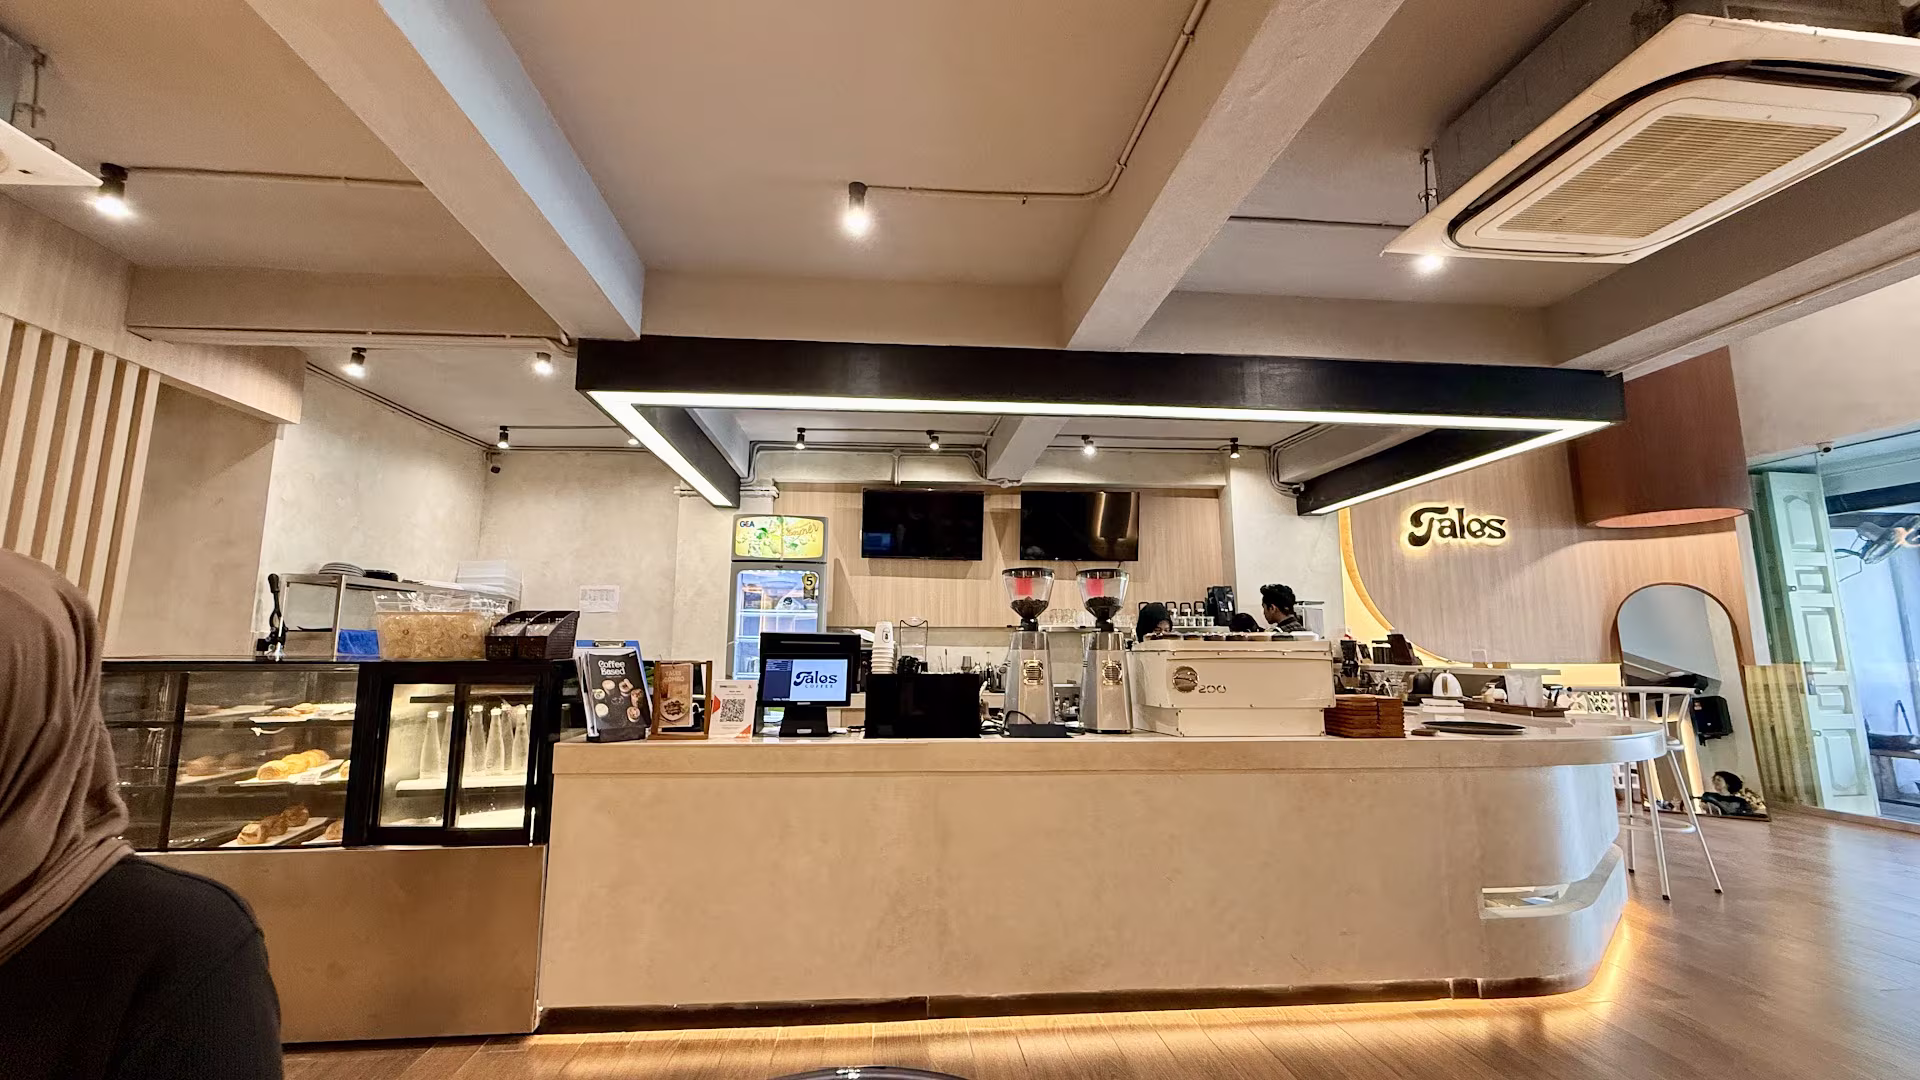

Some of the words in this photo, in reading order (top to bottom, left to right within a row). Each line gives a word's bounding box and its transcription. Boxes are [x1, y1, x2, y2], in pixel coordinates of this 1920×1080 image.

[739, 520, 755, 528] GEA
[1408, 506, 1506, 547] Tales
[806, 576, 813, 586] 5
[598, 660, 626, 668] Coffee
[600, 667, 626, 675] Based
[793, 671, 838, 687] Tales
